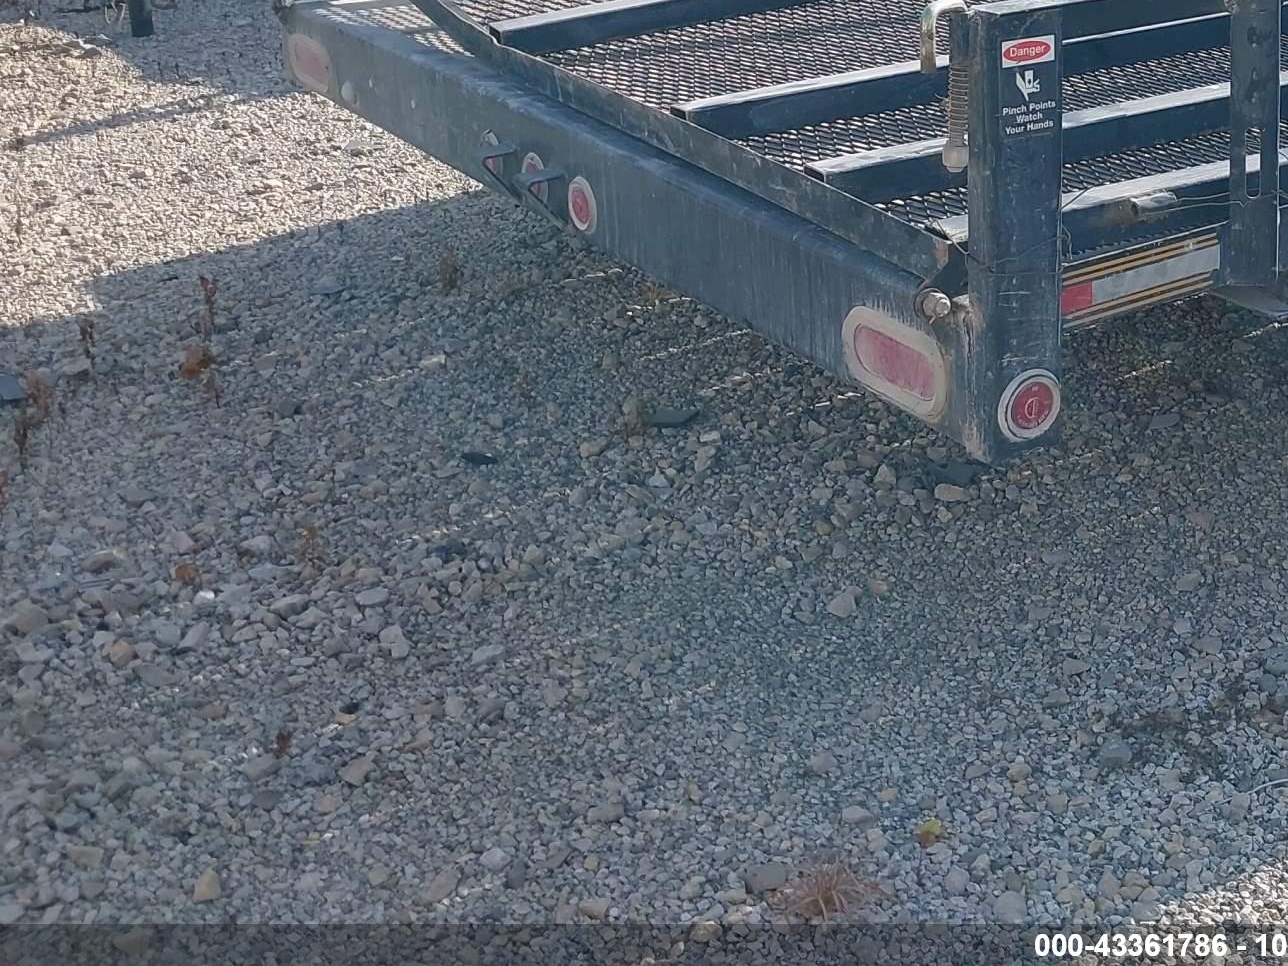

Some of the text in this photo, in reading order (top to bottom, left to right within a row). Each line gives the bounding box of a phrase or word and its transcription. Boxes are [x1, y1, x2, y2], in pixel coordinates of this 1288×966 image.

[1010, 45, 1046, 57] Danger
[1003, 100, 1056, 116] Pinch Points
[1016, 112, 1043, 123] Watch
[1005, 119, 1054, 135] Your Hands
